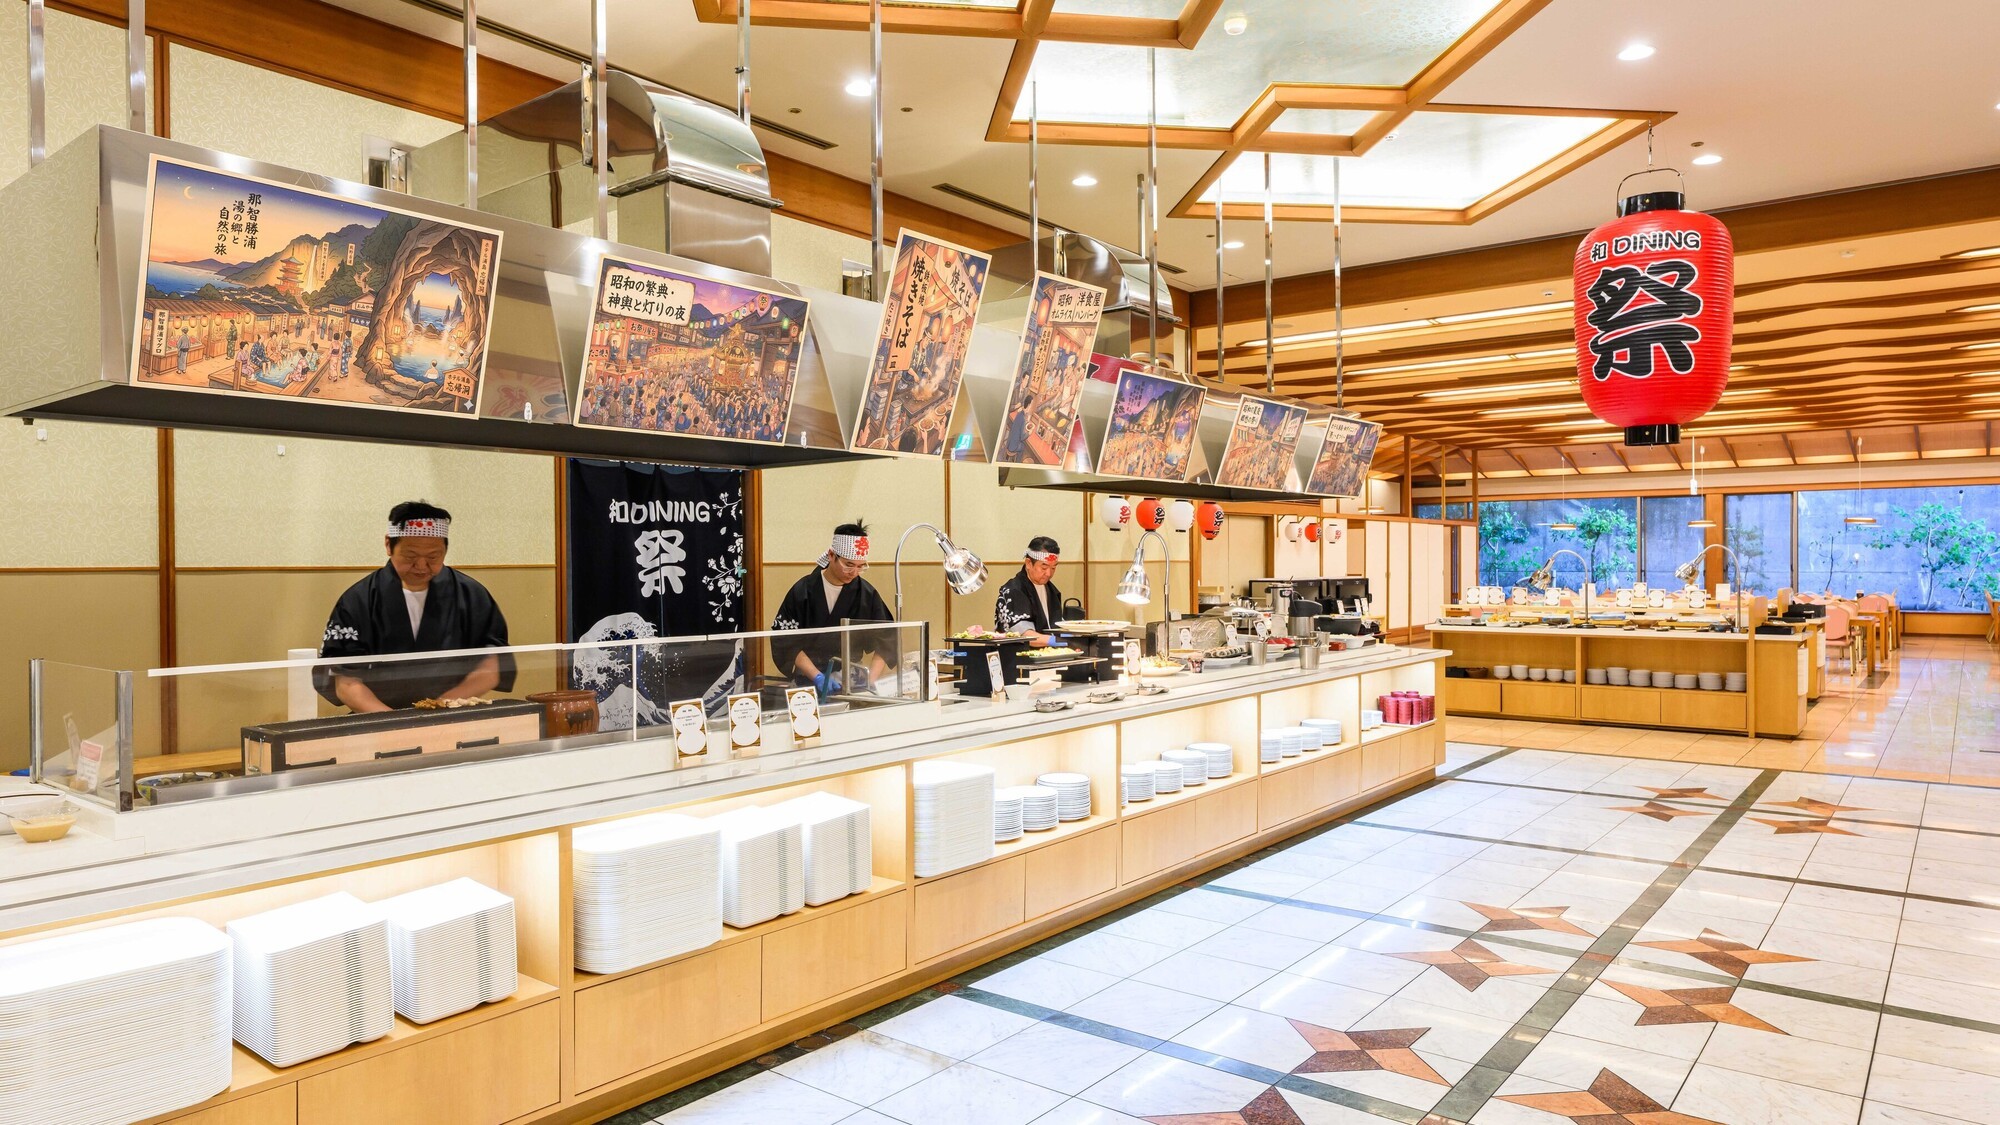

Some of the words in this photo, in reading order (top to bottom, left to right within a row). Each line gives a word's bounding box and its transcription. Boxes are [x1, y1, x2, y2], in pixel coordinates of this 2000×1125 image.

[214, 206, 230, 256] 自然の旅
[231, 200, 245, 245] 湯の郷と
[244, 193, 262, 250] 那智勝浦
[1592, 242, 1607, 261] 和
[1613, 231, 1700, 255] DINING
[607, 292, 686, 321] 神輿と灯りの夜
[895, 255, 926, 349] 焼きそば
[949, 266, 973, 307] 焼そば
[1057, 294, 1072, 307] 昭和
[1076, 291, 1101, 307] 洋食屋
[1050, 309, 1072, 320] オムライス
[1075, 309, 1098, 320] ハンバーグ
[1587, 261, 1703, 381] 祭
[609, 499, 710, 524] 和DINING
[634, 529, 686, 598] 祭
